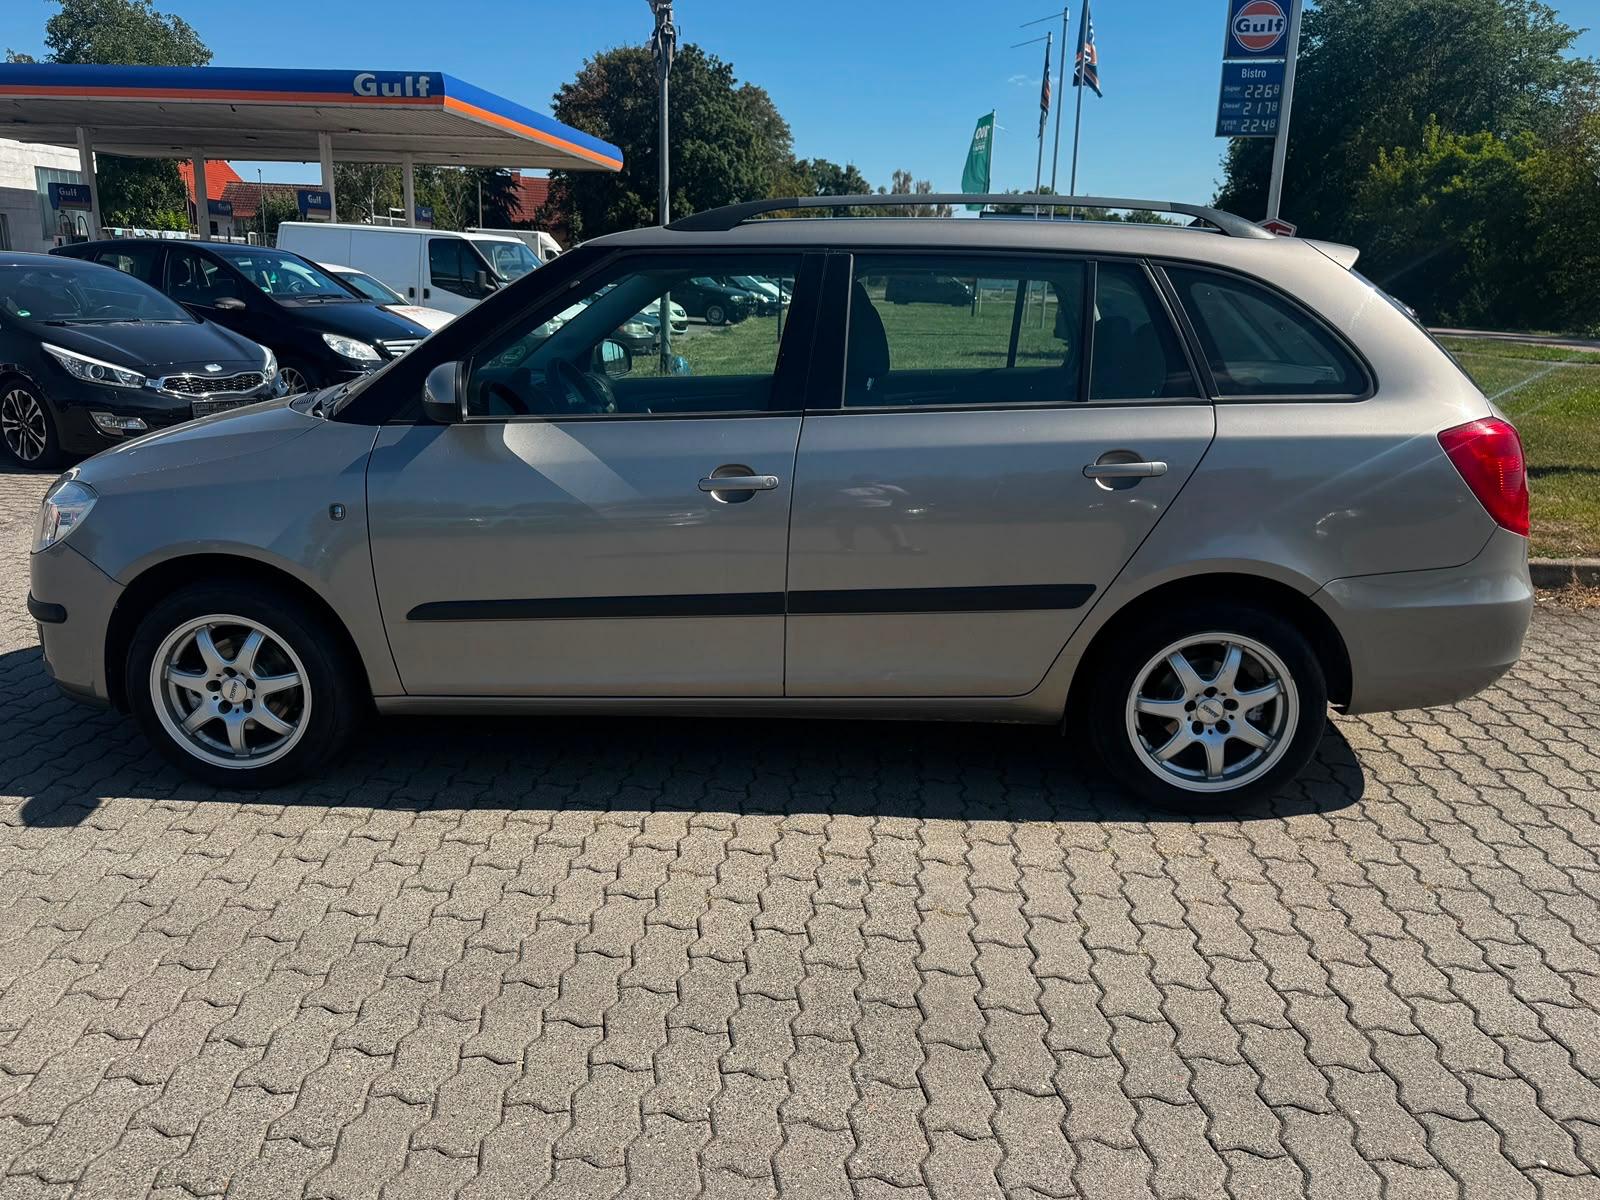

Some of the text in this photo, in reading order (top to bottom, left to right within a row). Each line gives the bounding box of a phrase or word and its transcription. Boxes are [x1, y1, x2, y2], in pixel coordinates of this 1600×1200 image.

[1235, 18, 1284, 33] Gulf
[1241, 68, 1267, 78] Bistro
[353, 73, 430, 97] Gulf
[58, 187, 78, 197] Gulf
[307, 194, 321, 205] Gulf
